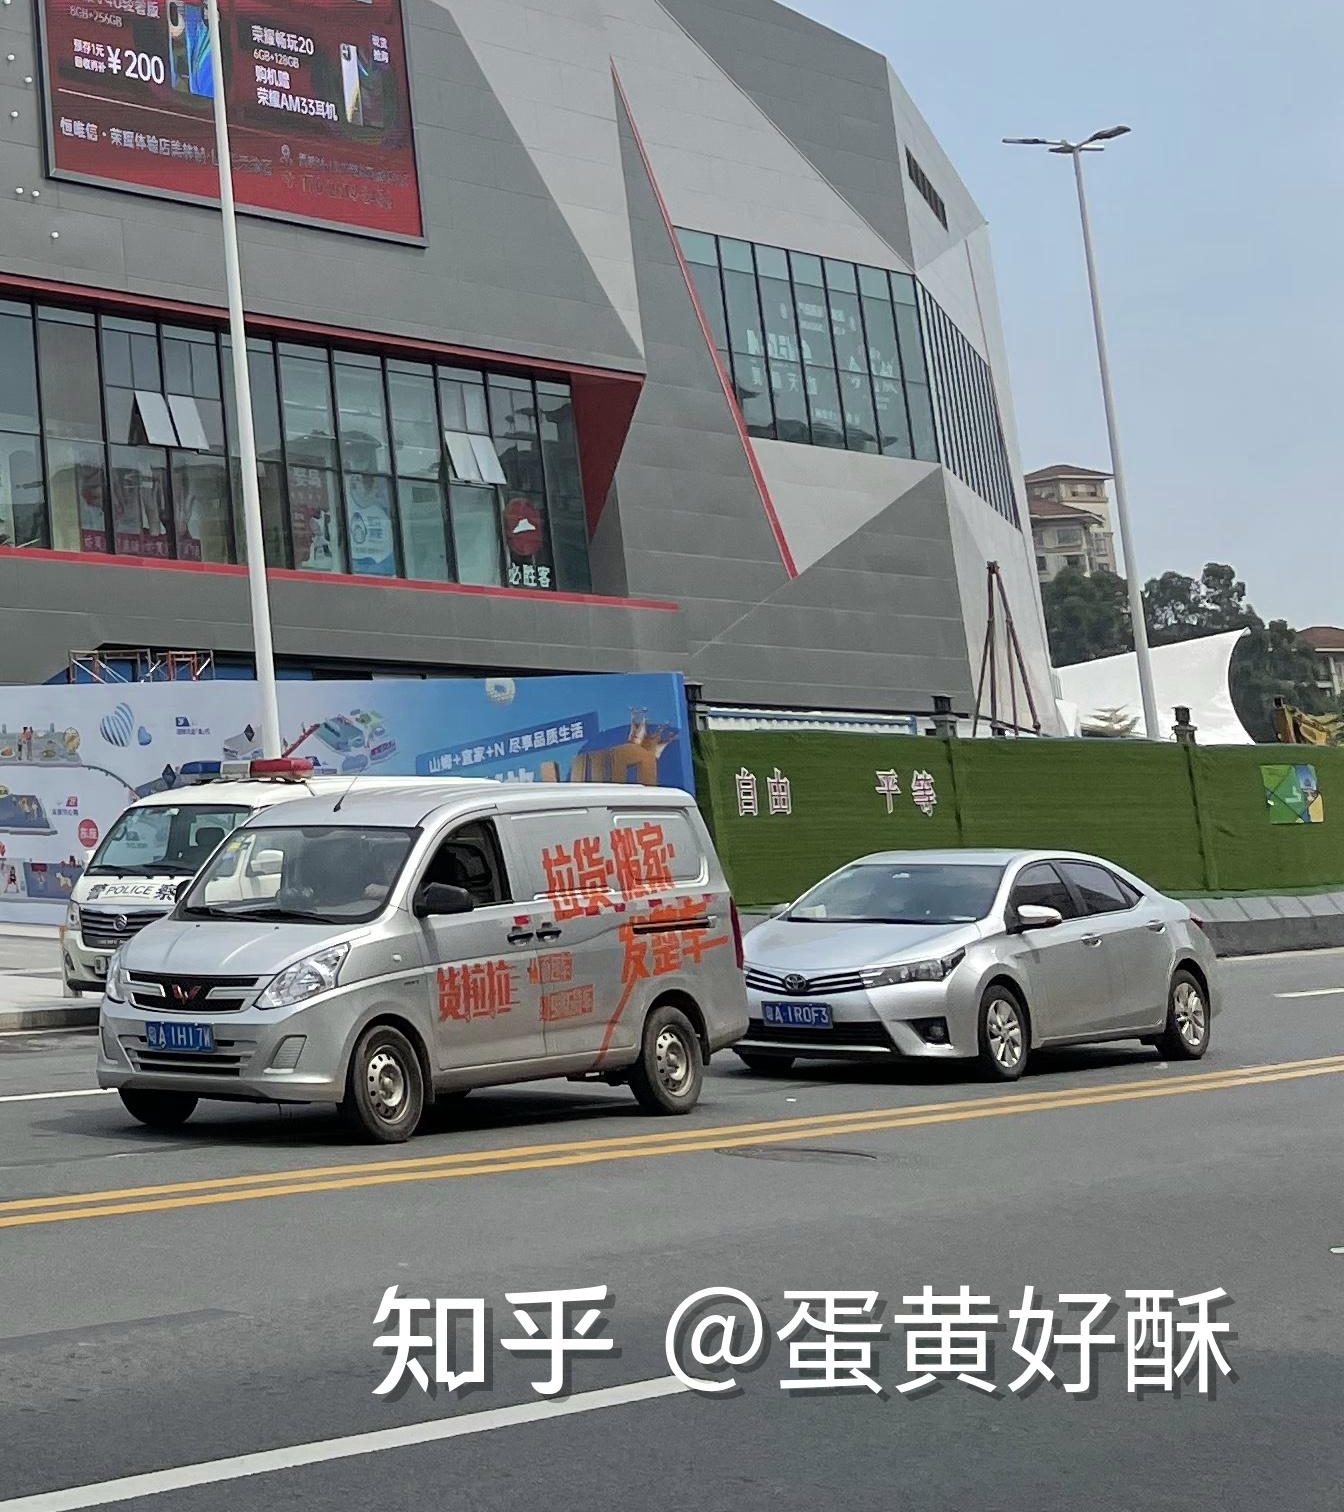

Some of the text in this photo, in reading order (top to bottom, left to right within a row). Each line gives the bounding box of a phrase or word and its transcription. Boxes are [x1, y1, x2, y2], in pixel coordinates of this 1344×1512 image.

[508, 562, 551, 588] 必胜客
[736, 767, 792, 816] 自由
[106, 885, 155, 895] POLICE
[437, 959, 513, 1023] 货拉拉
